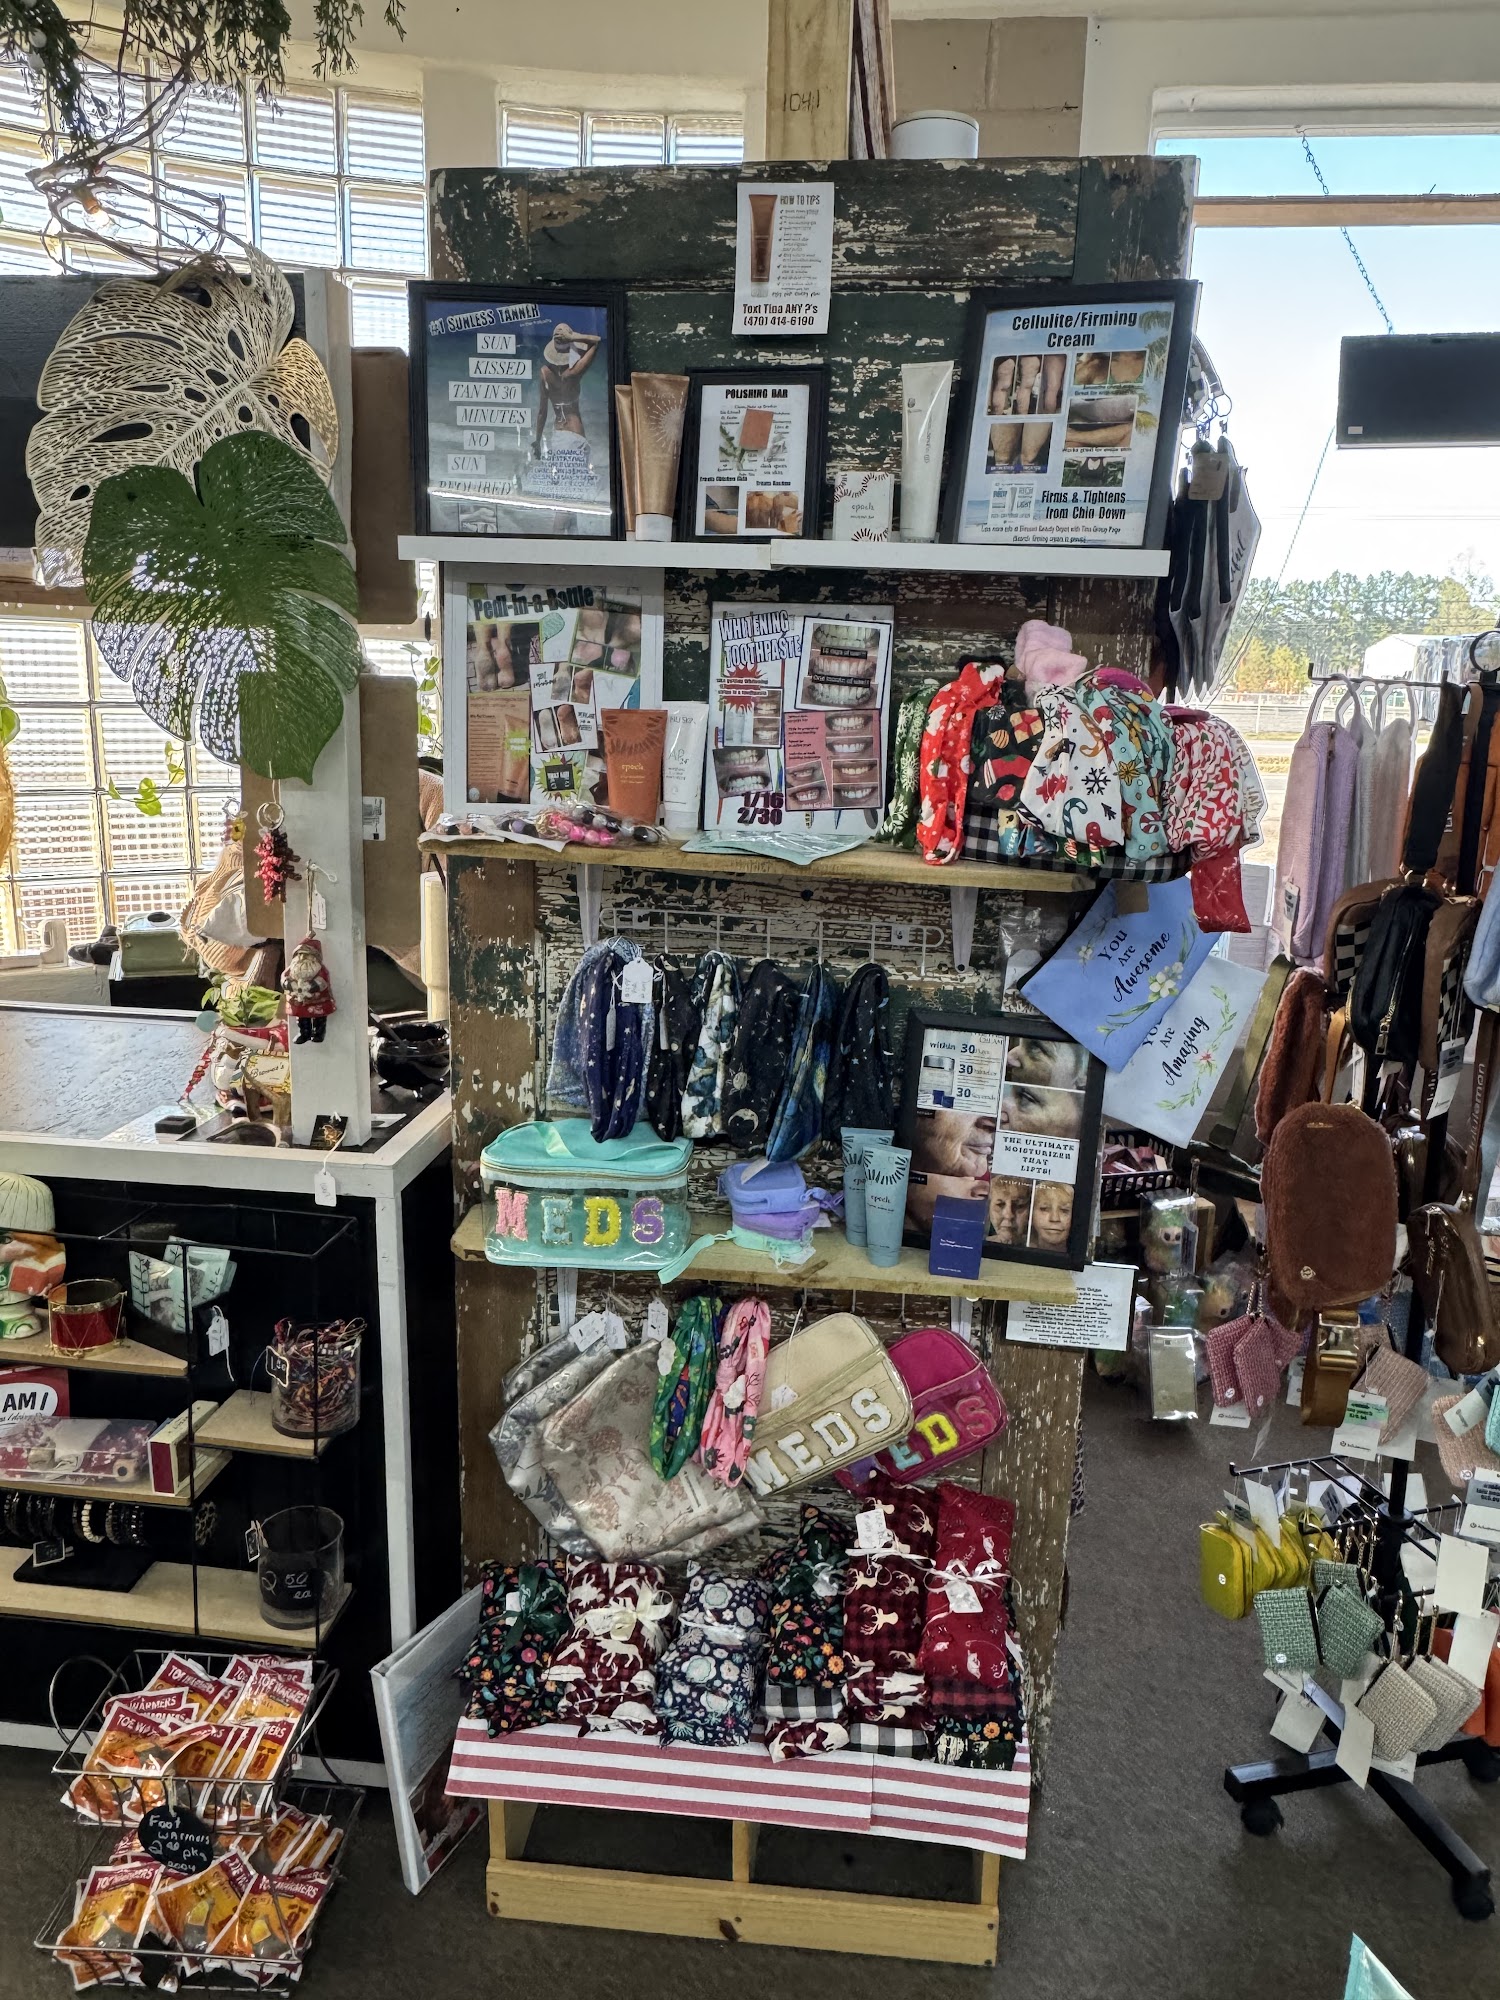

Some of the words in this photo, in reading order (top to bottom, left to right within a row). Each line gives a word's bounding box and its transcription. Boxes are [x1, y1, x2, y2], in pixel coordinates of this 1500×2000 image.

[796, 195, 805, 205] TO
[742, 303, 762, 314] Text
[763, 303, 783, 314] Tina
[785, 303, 803, 314] ANY
[446, 309, 495, 331] SUNLESS
[497, 303, 540, 323] TANNER
[743, 316, 768, 326] (470)
[1012, 311, 1138, 332] Cellulite/Firming
[480, 335, 512, 351] SUN
[1047, 333, 1095, 348] Cream
[473, 360, 526, 376] KISSED
[453, 384, 481, 398] TAN
[483, 385, 501, 399] IN
[501, 386, 517, 400] 30
[725, 388, 768, 399] POLISHING
[771, 388, 788, 399] BAR
[460, 408, 527, 424] MINUTES
[467, 433, 489, 447] NO
[450, 456, 480, 471] SUN
[1041, 490, 1068, 504] Firms
[1071, 491, 1079, 503] &
[1083, 490, 1126, 504] Tightens
[1045, 506, 1069, 519] from
[1072, 506, 1095, 519] Chin
[1098, 506, 1126, 519] Down
[719, 610, 789, 641] WHITENING
[724, 634, 801, 668] TOOTHPASTE
[741, 790, 785, 808] 1/16
[737, 806, 783, 825] 2/30
[1117, 944, 1136, 967] Are
[1113, 931, 1170, 1003] Awesome
[1159, 1027, 1176, 1049] Are
[960, 1043, 976, 1054] 30
[1165, 1014, 1210, 1087] Amazing
[958, 1064, 974, 1075] 30
[956, 1087, 971, 1098] 30
[1002, 1136, 1022, 1144] THE
[1025, 1138, 1075, 1151] ULTIMATE
[1004, 1145, 1071, 1160] MOISTURIZER
[1022, 1156, 1049, 1166] THAT
[494, 1185, 665, 1247] MEDS
[2, 1391, 37, 1413] AM
[746, 1386, 893, 1497] MEDS
[116, 1713, 136, 1730] TOE
[148, 1814, 182, 1830] Foot
